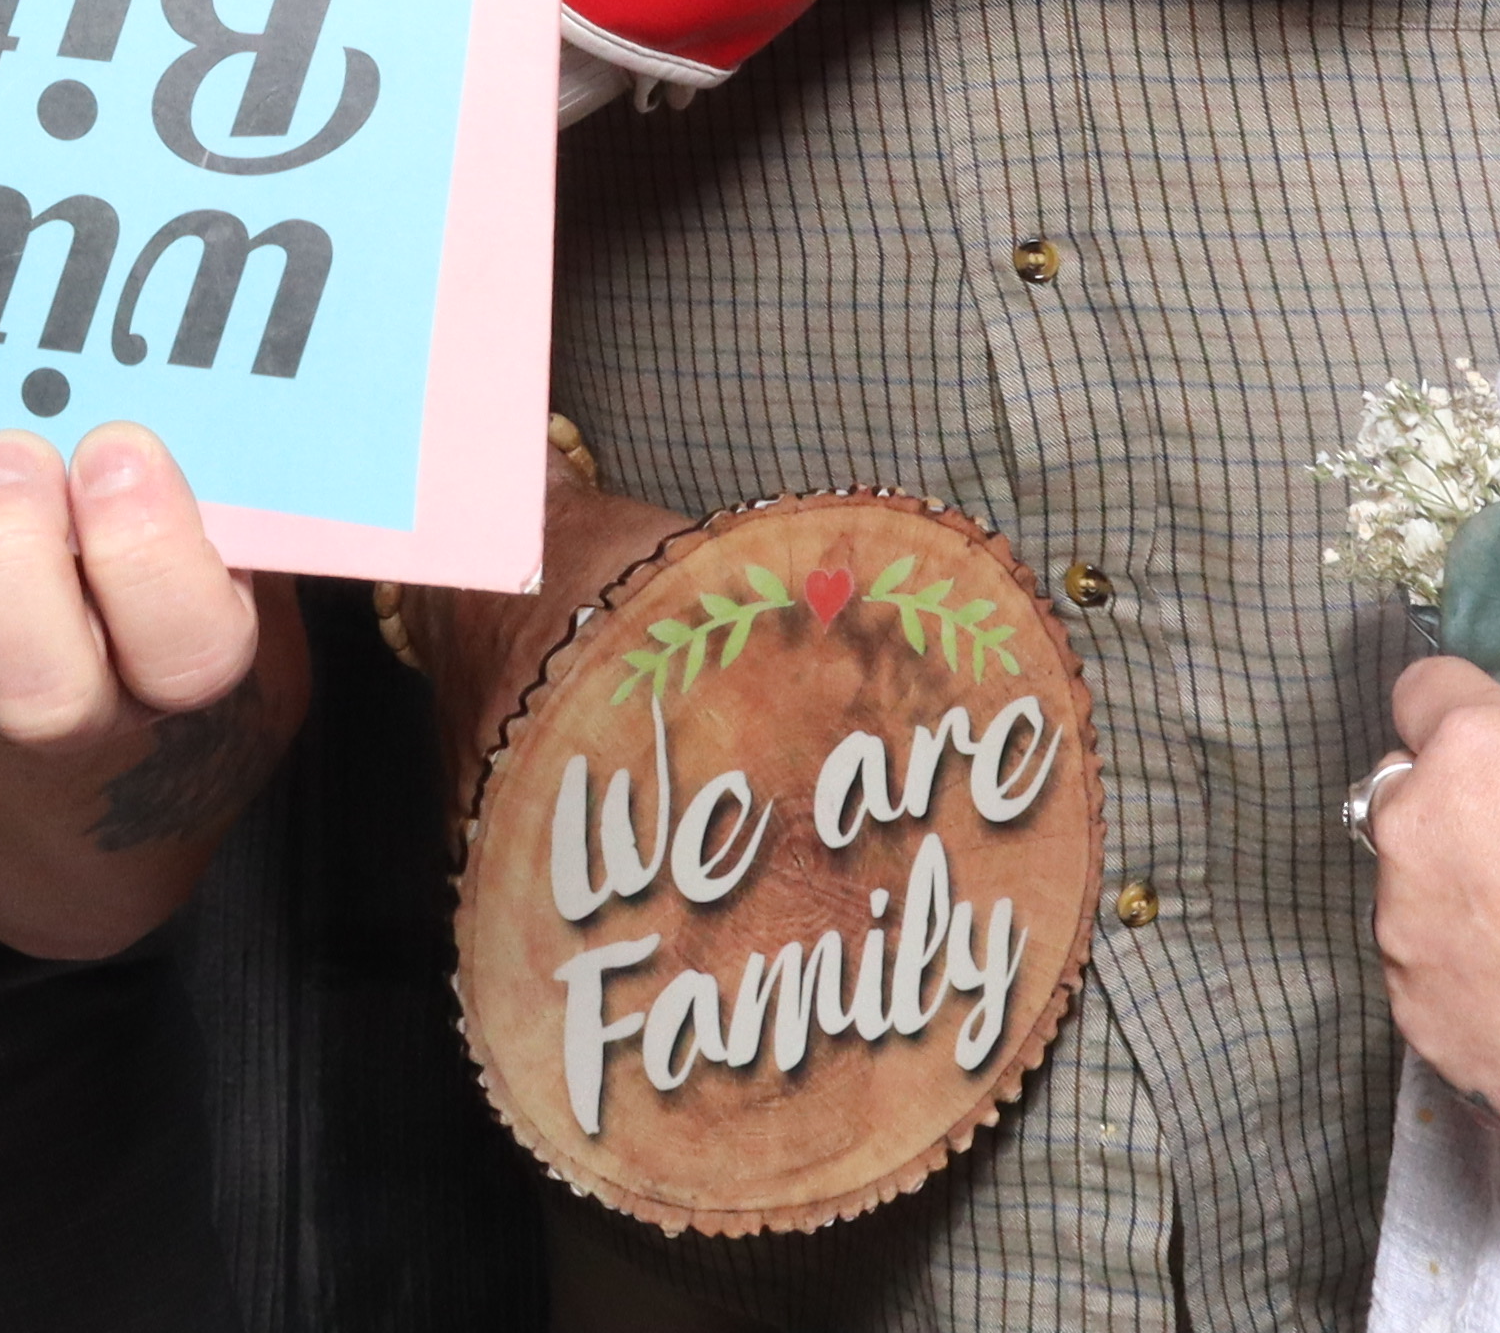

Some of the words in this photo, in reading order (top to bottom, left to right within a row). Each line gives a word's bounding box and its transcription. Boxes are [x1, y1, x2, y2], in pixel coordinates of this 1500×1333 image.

[551, 695, 774, 920] We
[813, 695, 1063, 849] are
[553, 833, 1029, 1135] Family
